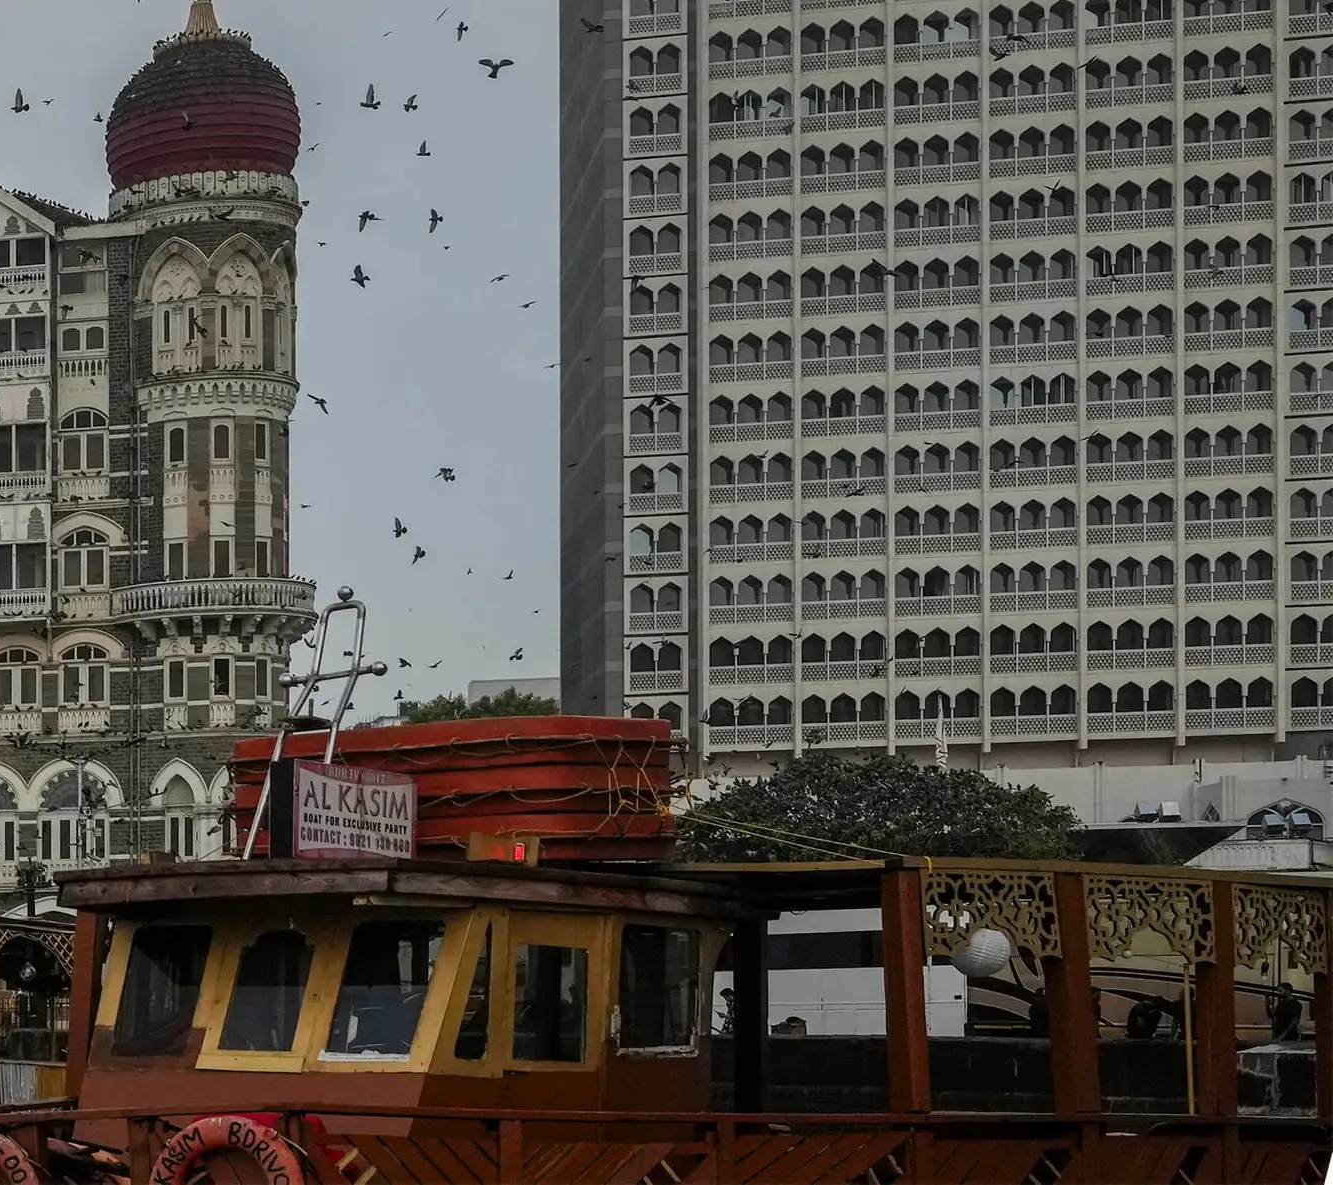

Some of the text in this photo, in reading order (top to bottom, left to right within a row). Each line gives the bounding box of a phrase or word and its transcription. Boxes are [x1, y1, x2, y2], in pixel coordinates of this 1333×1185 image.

[304, 780, 409, 821] AL KASIM
[303, 812, 408, 835] BOAT FOR EXCLUSIVE PARTY
[300, 826, 341, 845] CONTACT
